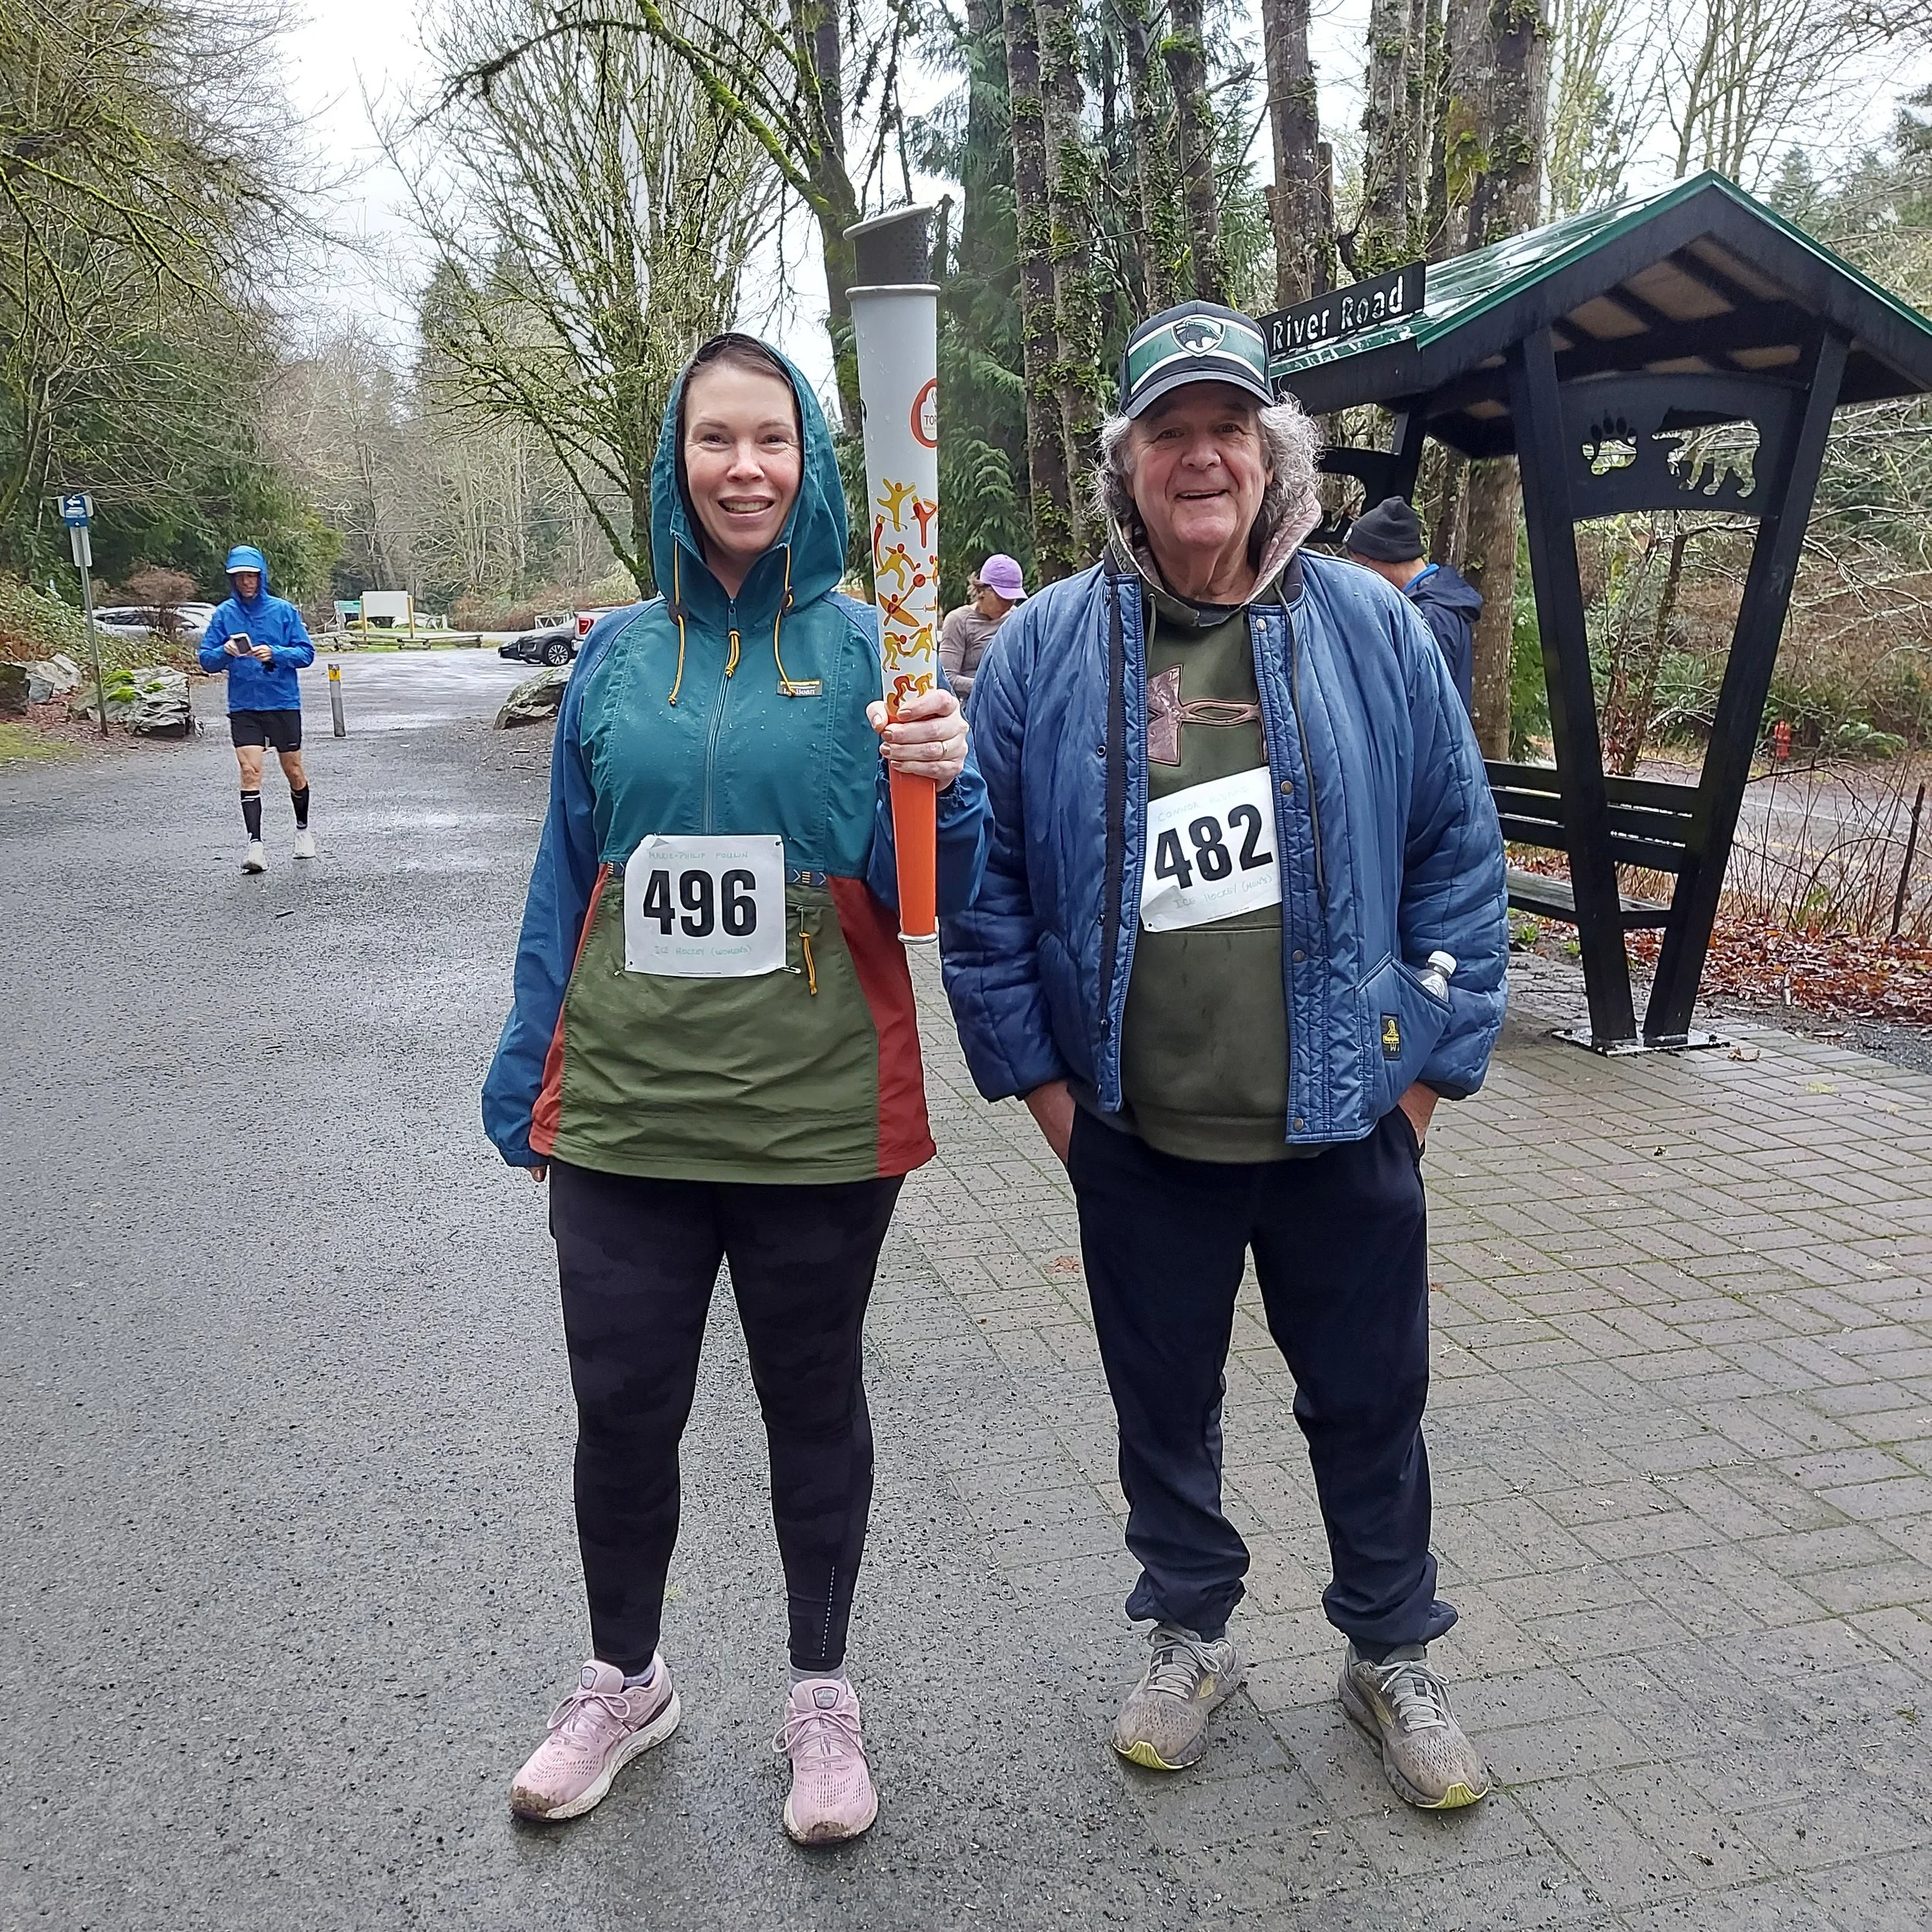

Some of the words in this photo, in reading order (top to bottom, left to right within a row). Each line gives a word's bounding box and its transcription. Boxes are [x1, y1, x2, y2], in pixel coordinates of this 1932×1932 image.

[1272, 308, 1331, 351] River
[1340, 274, 1404, 330] Road
[648, 851, 706, 859] MARIE-PHILIP
[715, 851, 749, 859] POULIN
[1154, 803, 1274, 890] 482
[643, 869, 758, 938] 496
[1172, 897, 1197, 910] ICE
[654, 945, 668, 954] ICE
